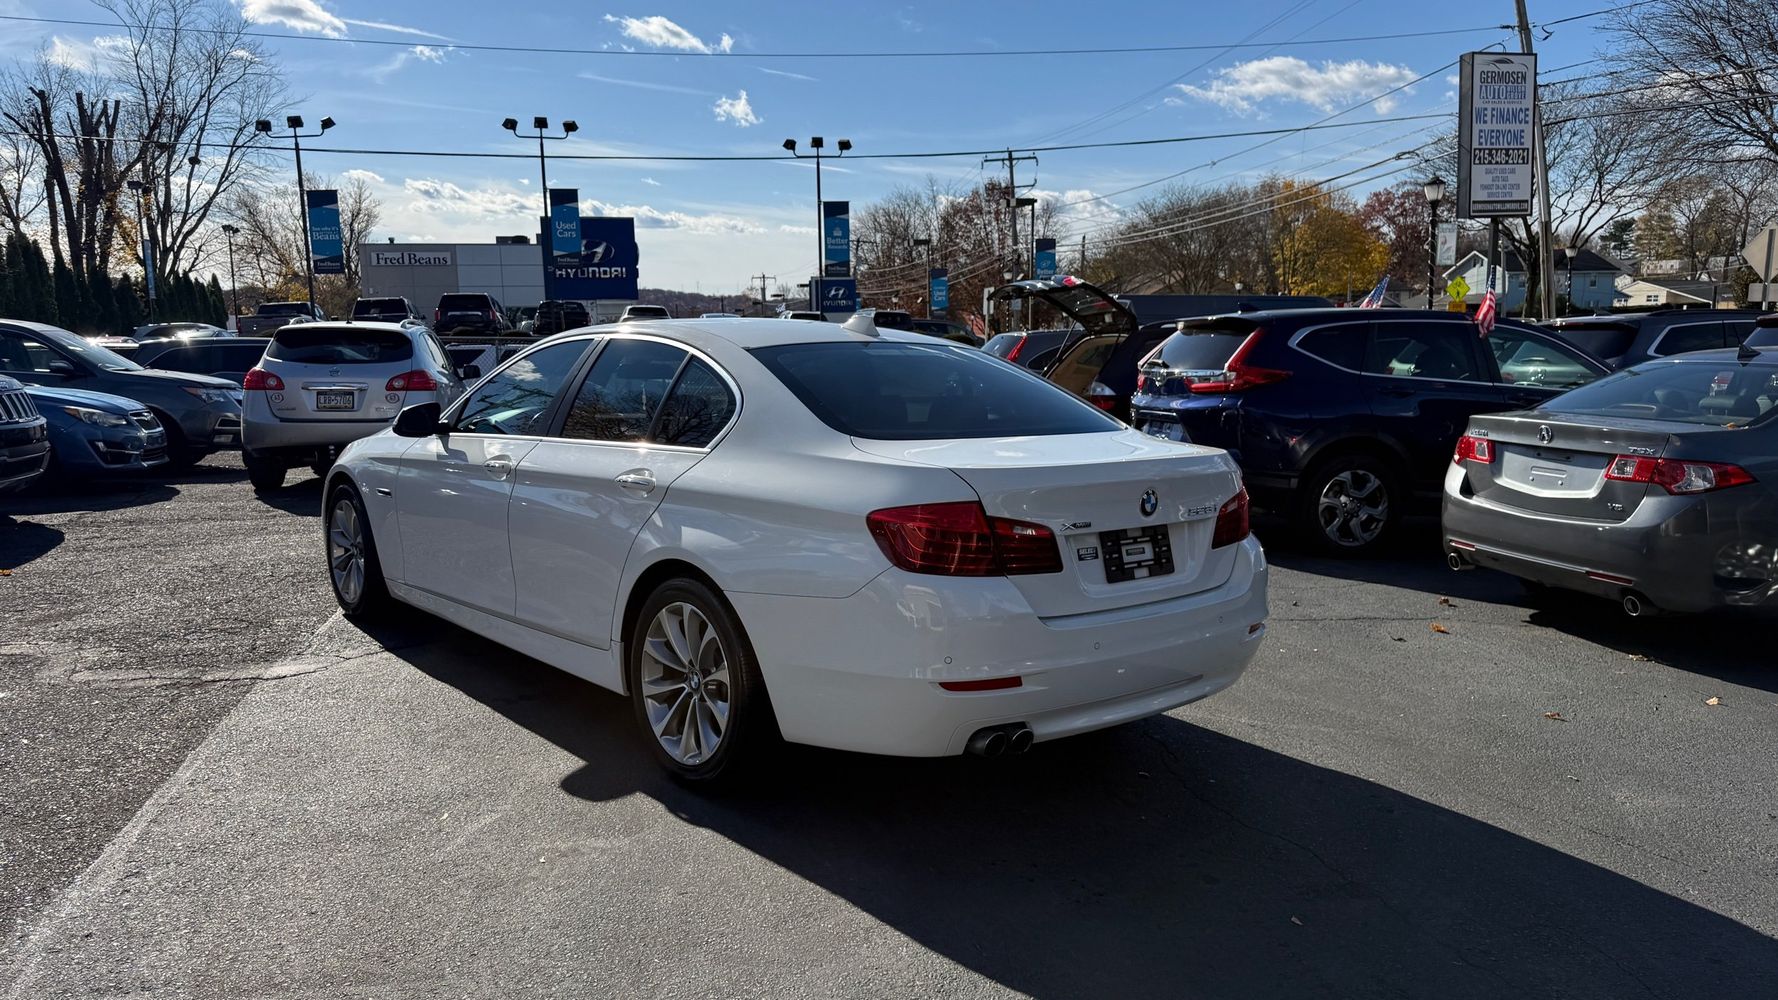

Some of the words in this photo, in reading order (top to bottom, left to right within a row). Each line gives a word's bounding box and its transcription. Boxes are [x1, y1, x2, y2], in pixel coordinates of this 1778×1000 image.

[1480, 70, 1527, 84] GERMOSEN
[1480, 85, 1506, 99] AUTO
[1475, 106, 1487, 125] WE
[1490, 107, 1529, 125] FINANCE
[1478, 128, 1524, 146] EVERYONE
[1474, 149, 1528, 164] 215-346-2021
[555, 221, 576, 230] Used
[312, 232, 340, 240] Beans
[556, 229, 576, 238] Cars
[376, 252, 405, 265] Fred
[407, 252, 448, 265] Beans
[555, 266, 627, 278] HYUNDAI
[1628, 446, 1656, 455] TSX
